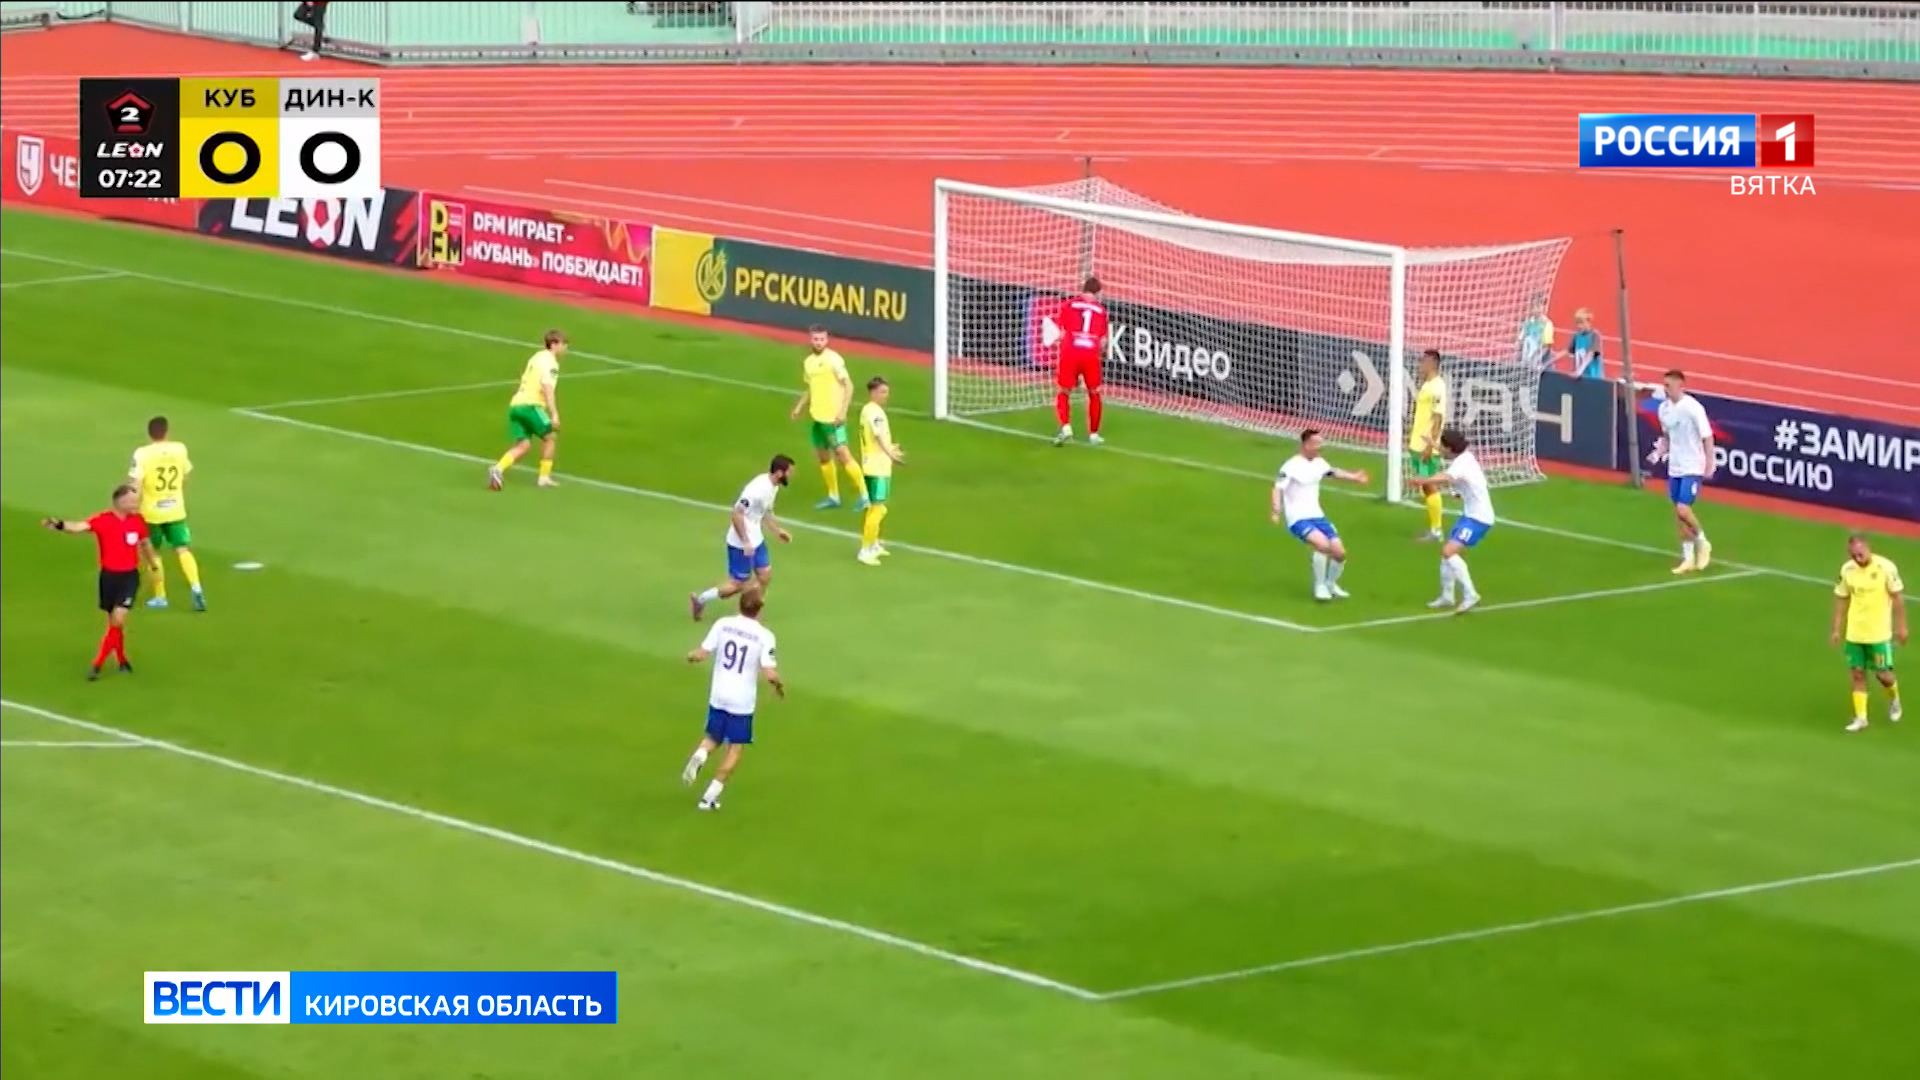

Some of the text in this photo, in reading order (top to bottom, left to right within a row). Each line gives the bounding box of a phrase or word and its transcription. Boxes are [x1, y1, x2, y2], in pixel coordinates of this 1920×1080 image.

[49, 153, 80, 188] ЧЕ
[472, 211, 504, 234] DFM
[507, 217, 565, 244] ИГРАЕТ
[466, 241, 643, 287] «КУБАНЬ» ПОБЕЖДАЕТ!
[733, 268, 907, 322] PFCKUBAN.RU
[1081, 310, 1093, 333] 1
[1134, 326, 1231, 382] Видео
[1774, 419, 1920, 471] #ЗАМИР
[155, 465, 179, 492] 32
[1713, 446, 1833, 492] РОССИЮ
[723, 640, 748, 674] 91
